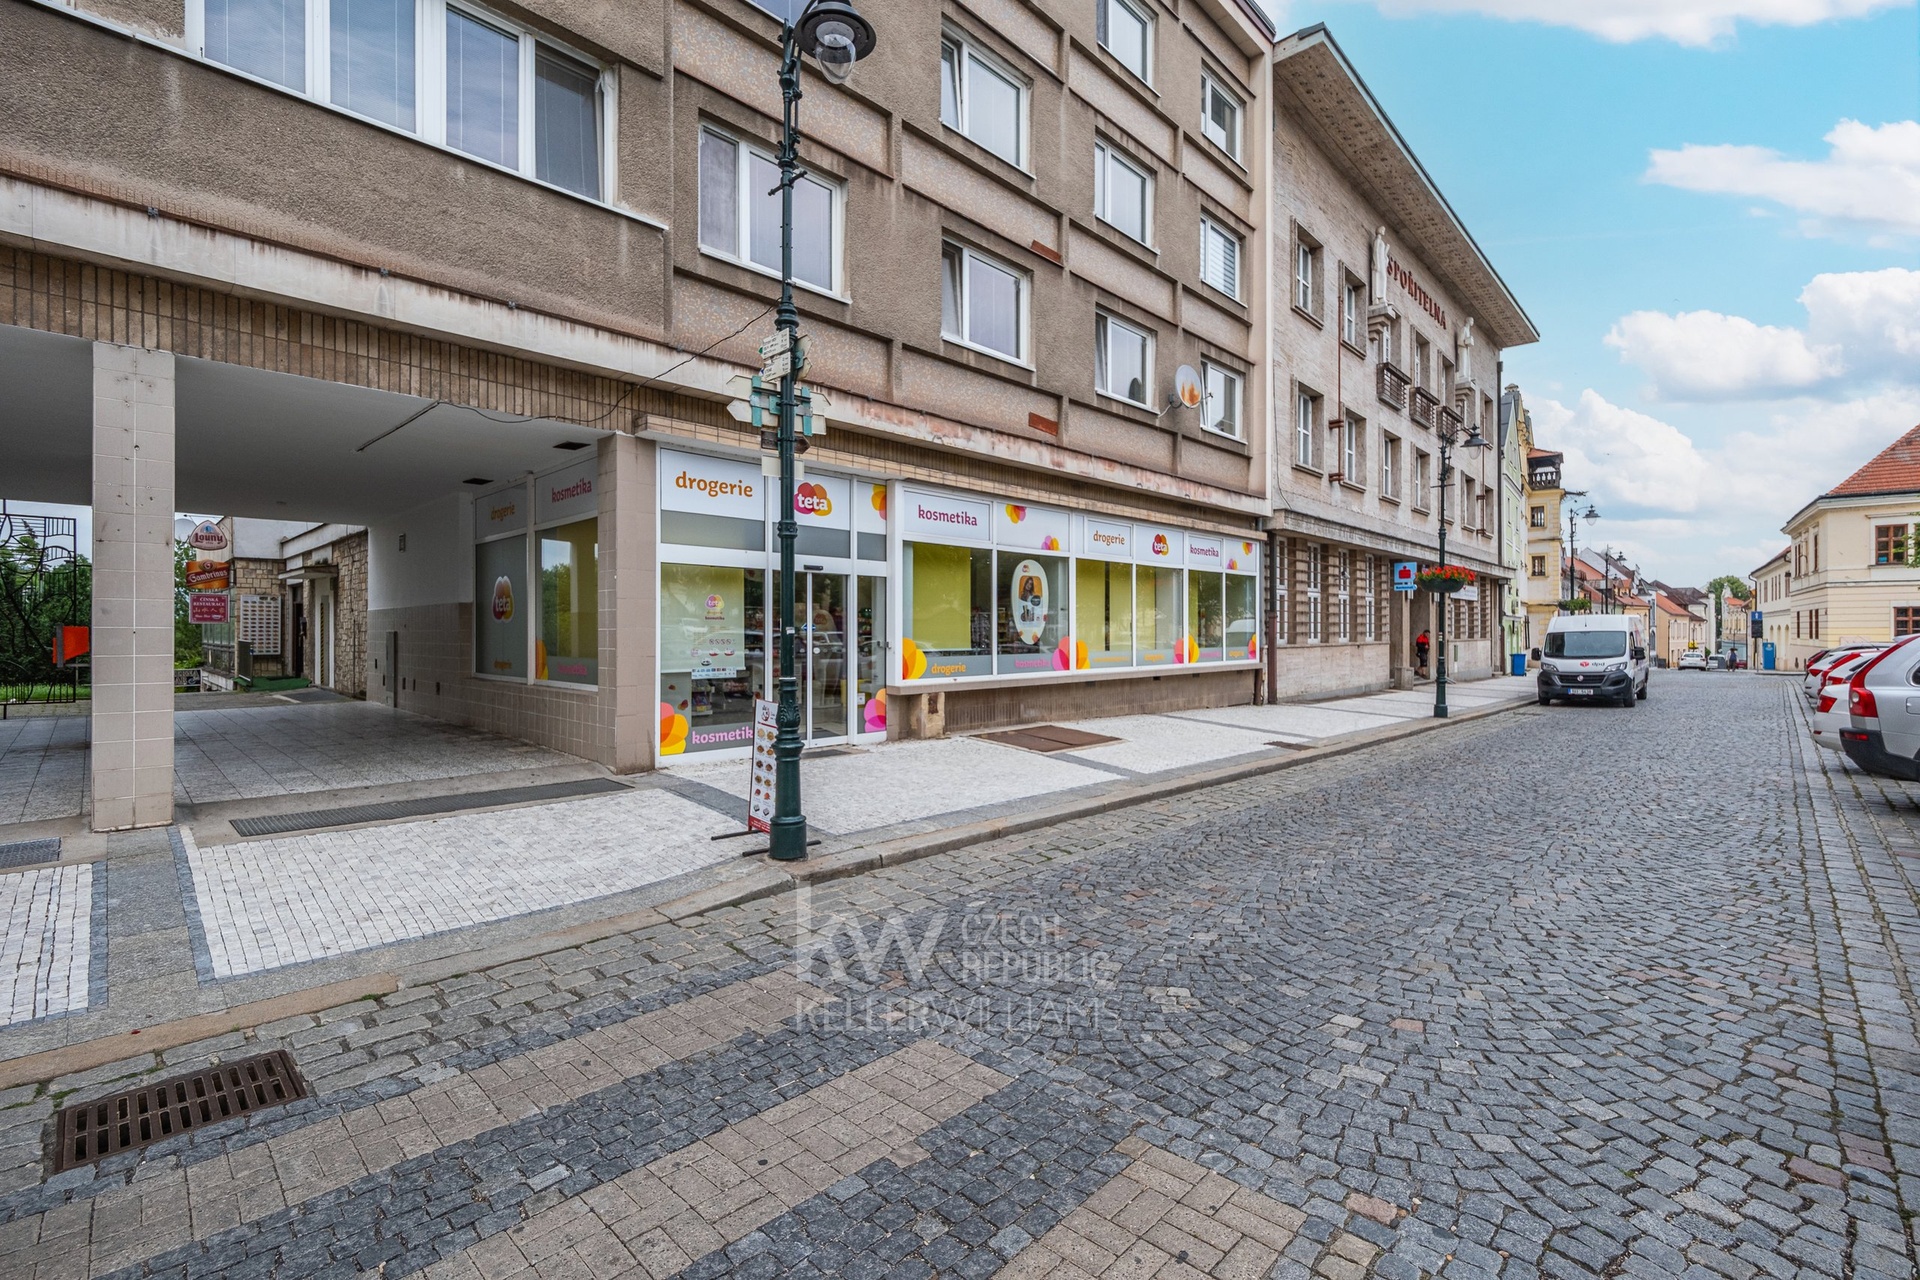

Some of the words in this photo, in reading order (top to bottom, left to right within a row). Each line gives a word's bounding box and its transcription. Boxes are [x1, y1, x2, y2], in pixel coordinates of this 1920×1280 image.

[1387, 256, 1446, 330] SPOŘITELNA
[551, 478, 592, 503] kosmetika
[675, 471, 753, 498] drogerie
[797, 493, 828, 511] teta
[490, 502, 515, 521] drogerie
[918, 504, 977, 526] kosmetika
[194, 532, 223, 544] Louny
[1093, 530, 1125, 546] drogerie
[1154, 542, 1168, 552] teta
[1190, 544, 1219, 558] kosmetika
[189, 569, 228, 583] Gambrinus
[495, 595, 511, 612] teta
[931, 663, 966, 676] drogerie
[691, 725, 754, 744] kosmetik
